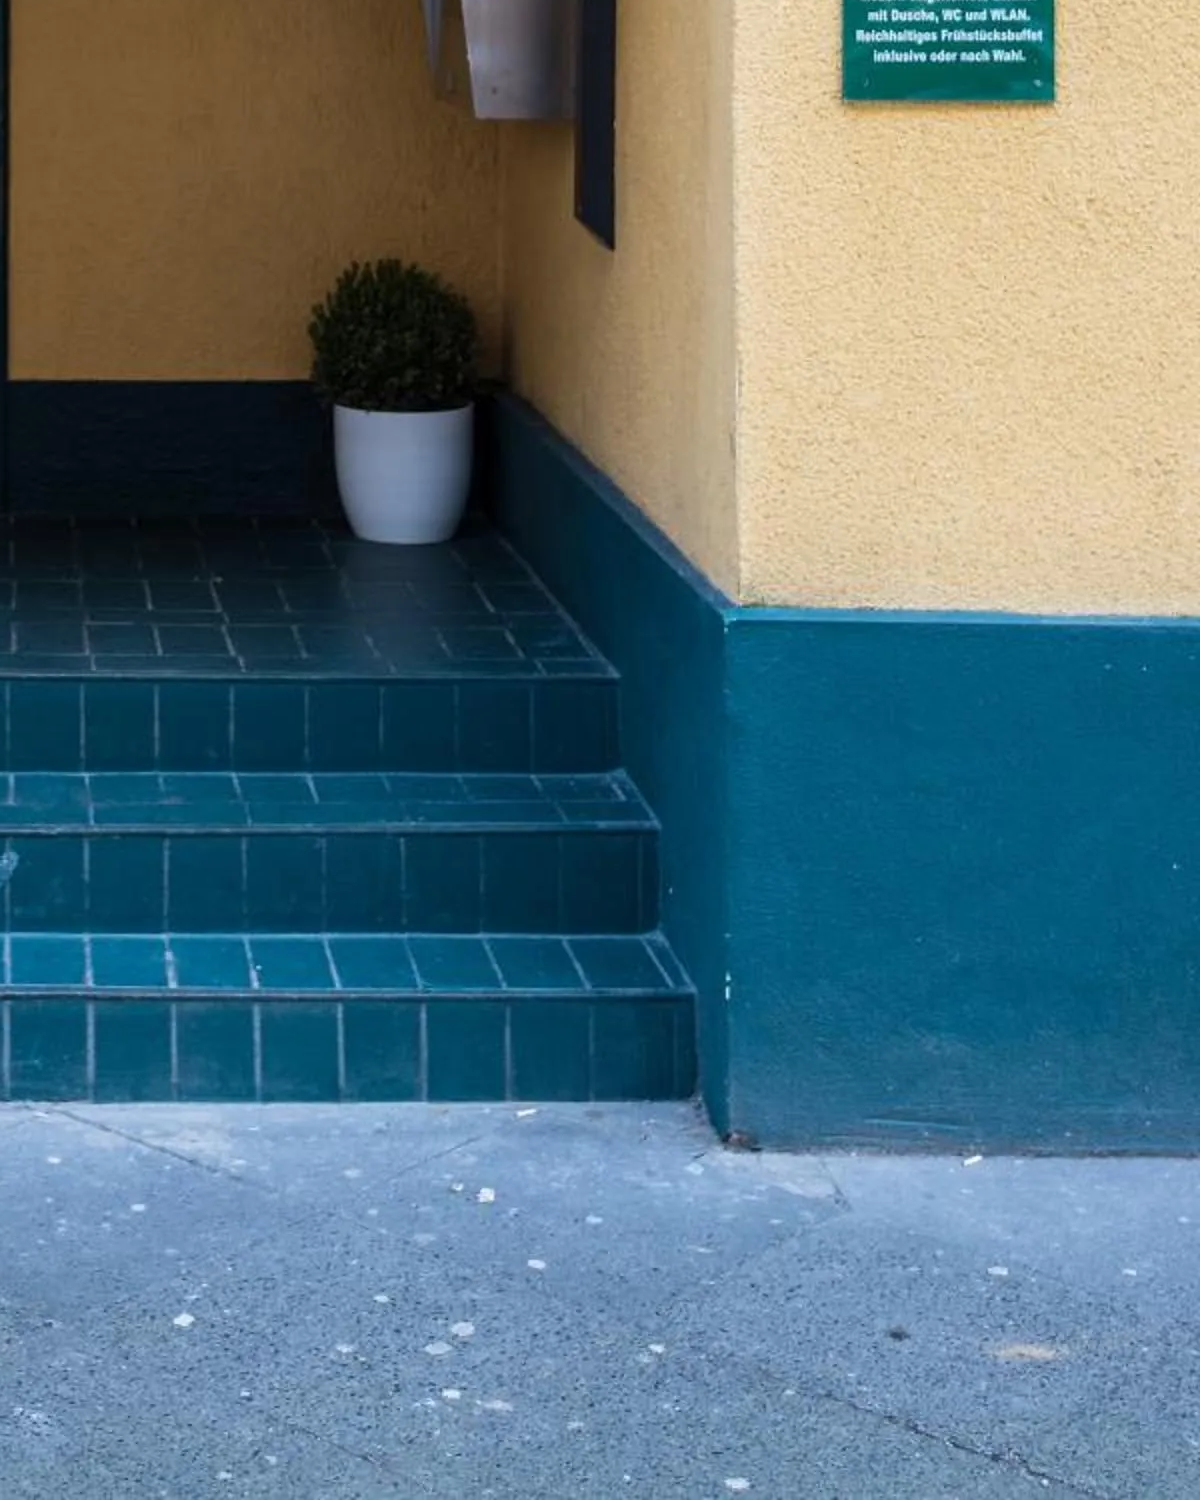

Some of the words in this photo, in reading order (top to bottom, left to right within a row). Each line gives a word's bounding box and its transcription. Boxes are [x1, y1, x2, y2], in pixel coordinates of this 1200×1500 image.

[867, 9, 888, 21] mit
[891, 8, 939, 23] Dusche,
[942, 9, 962, 21] WC
[965, 8, 987, 21] und
[990, 9, 1031, 21] WLAN.
[856, 29, 937, 44] Reichhaltiges
[873, 50, 927, 63] inklusive
[929, 50, 957, 63] oder
[960, 50, 989, 63] nach
[992, 50, 1026, 63] Wahl.
